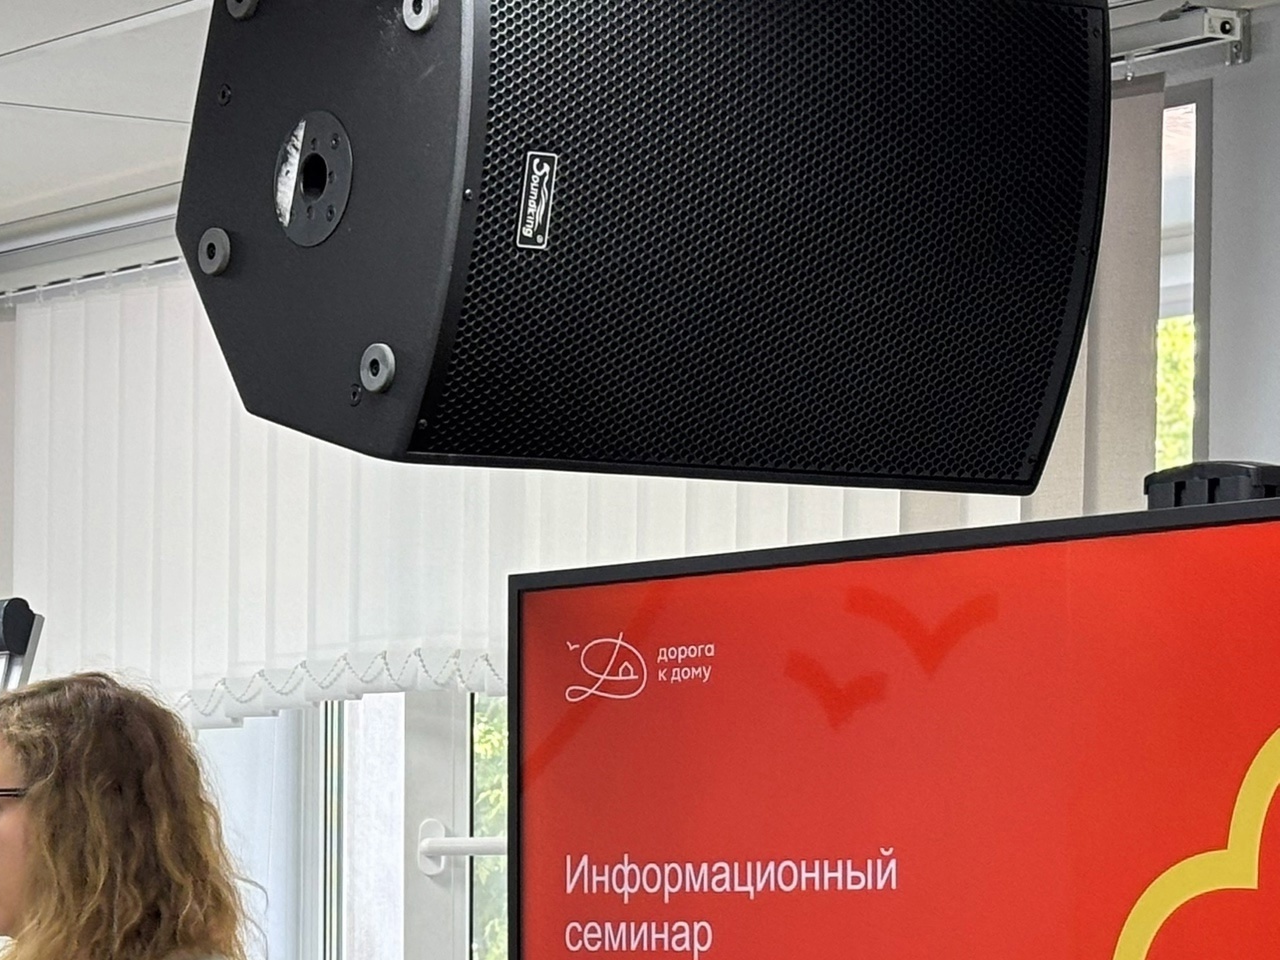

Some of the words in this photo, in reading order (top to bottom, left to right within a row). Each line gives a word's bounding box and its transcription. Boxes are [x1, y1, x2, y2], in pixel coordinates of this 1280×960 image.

[522, 158, 550, 238] Soundking
[657, 644, 714, 663] дорога
[659, 669, 667, 680] к
[671, 666, 712, 684] дому
[567, 848, 896, 904] Информационный
[566, 922, 712, 960] семинар
